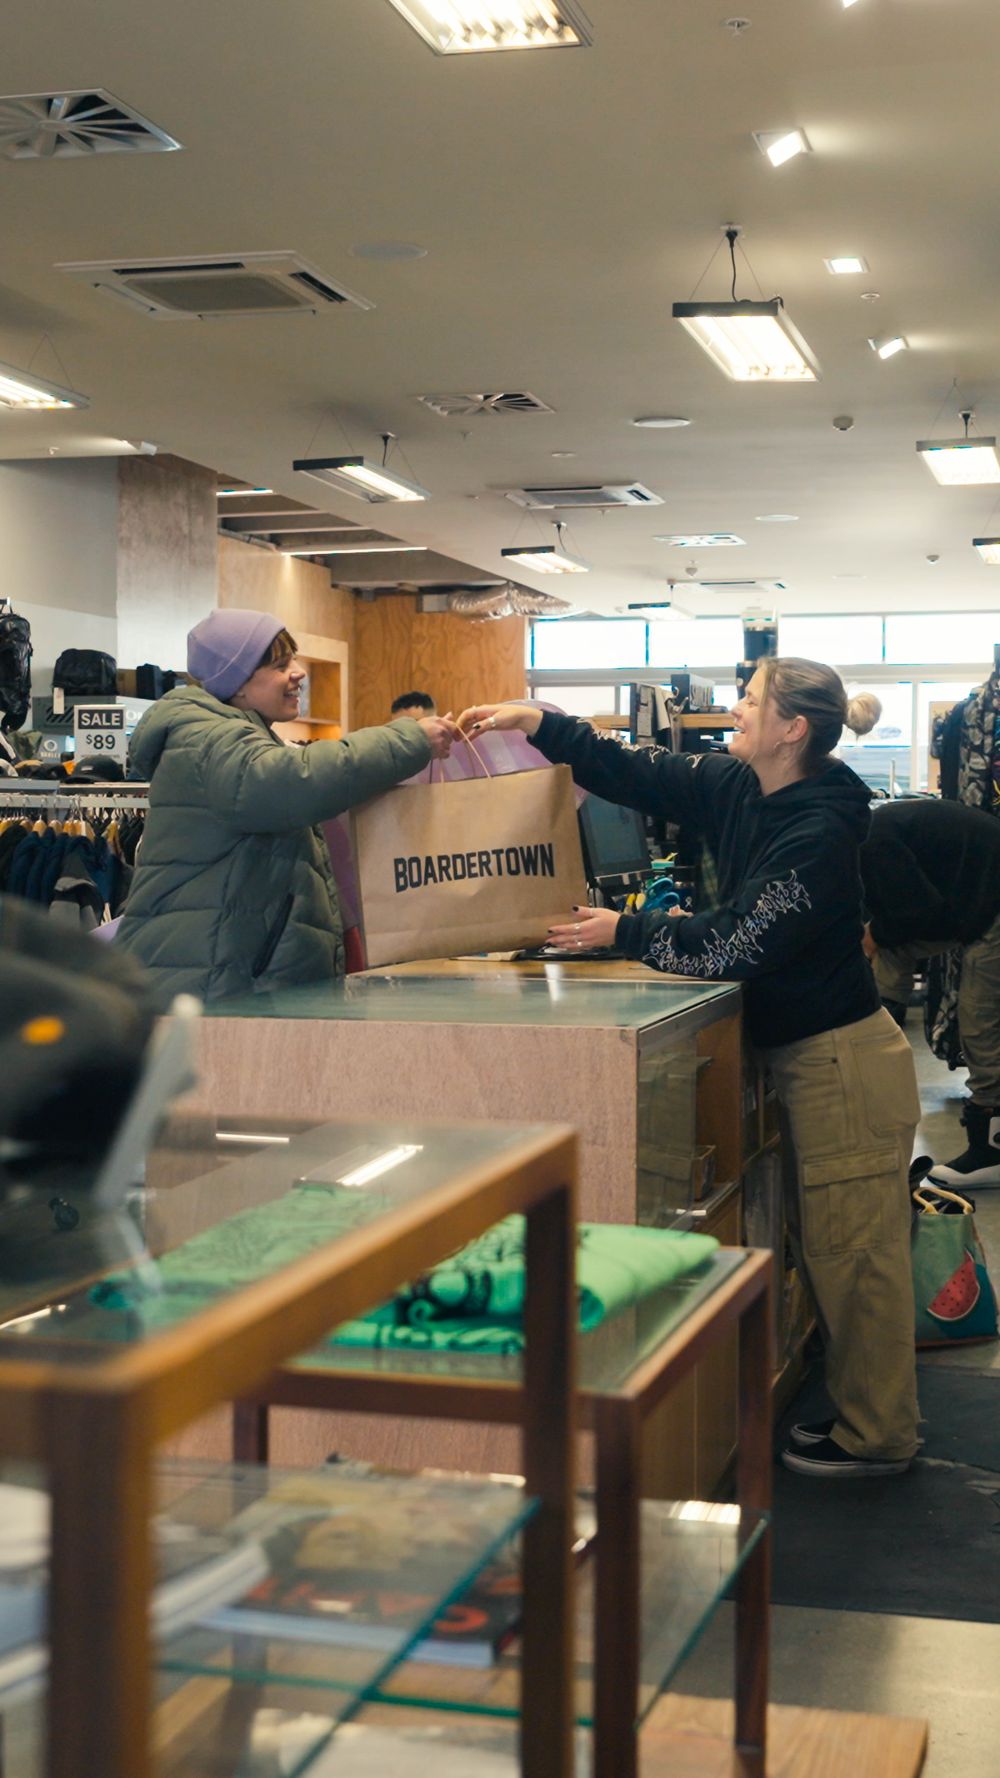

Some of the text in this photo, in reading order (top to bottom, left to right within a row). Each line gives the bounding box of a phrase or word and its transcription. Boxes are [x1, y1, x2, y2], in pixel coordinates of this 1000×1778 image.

[81, 713, 121, 726] SALE
[86, 734, 115, 750] $89
[394, 843, 554, 893] BOARDERTOWN
